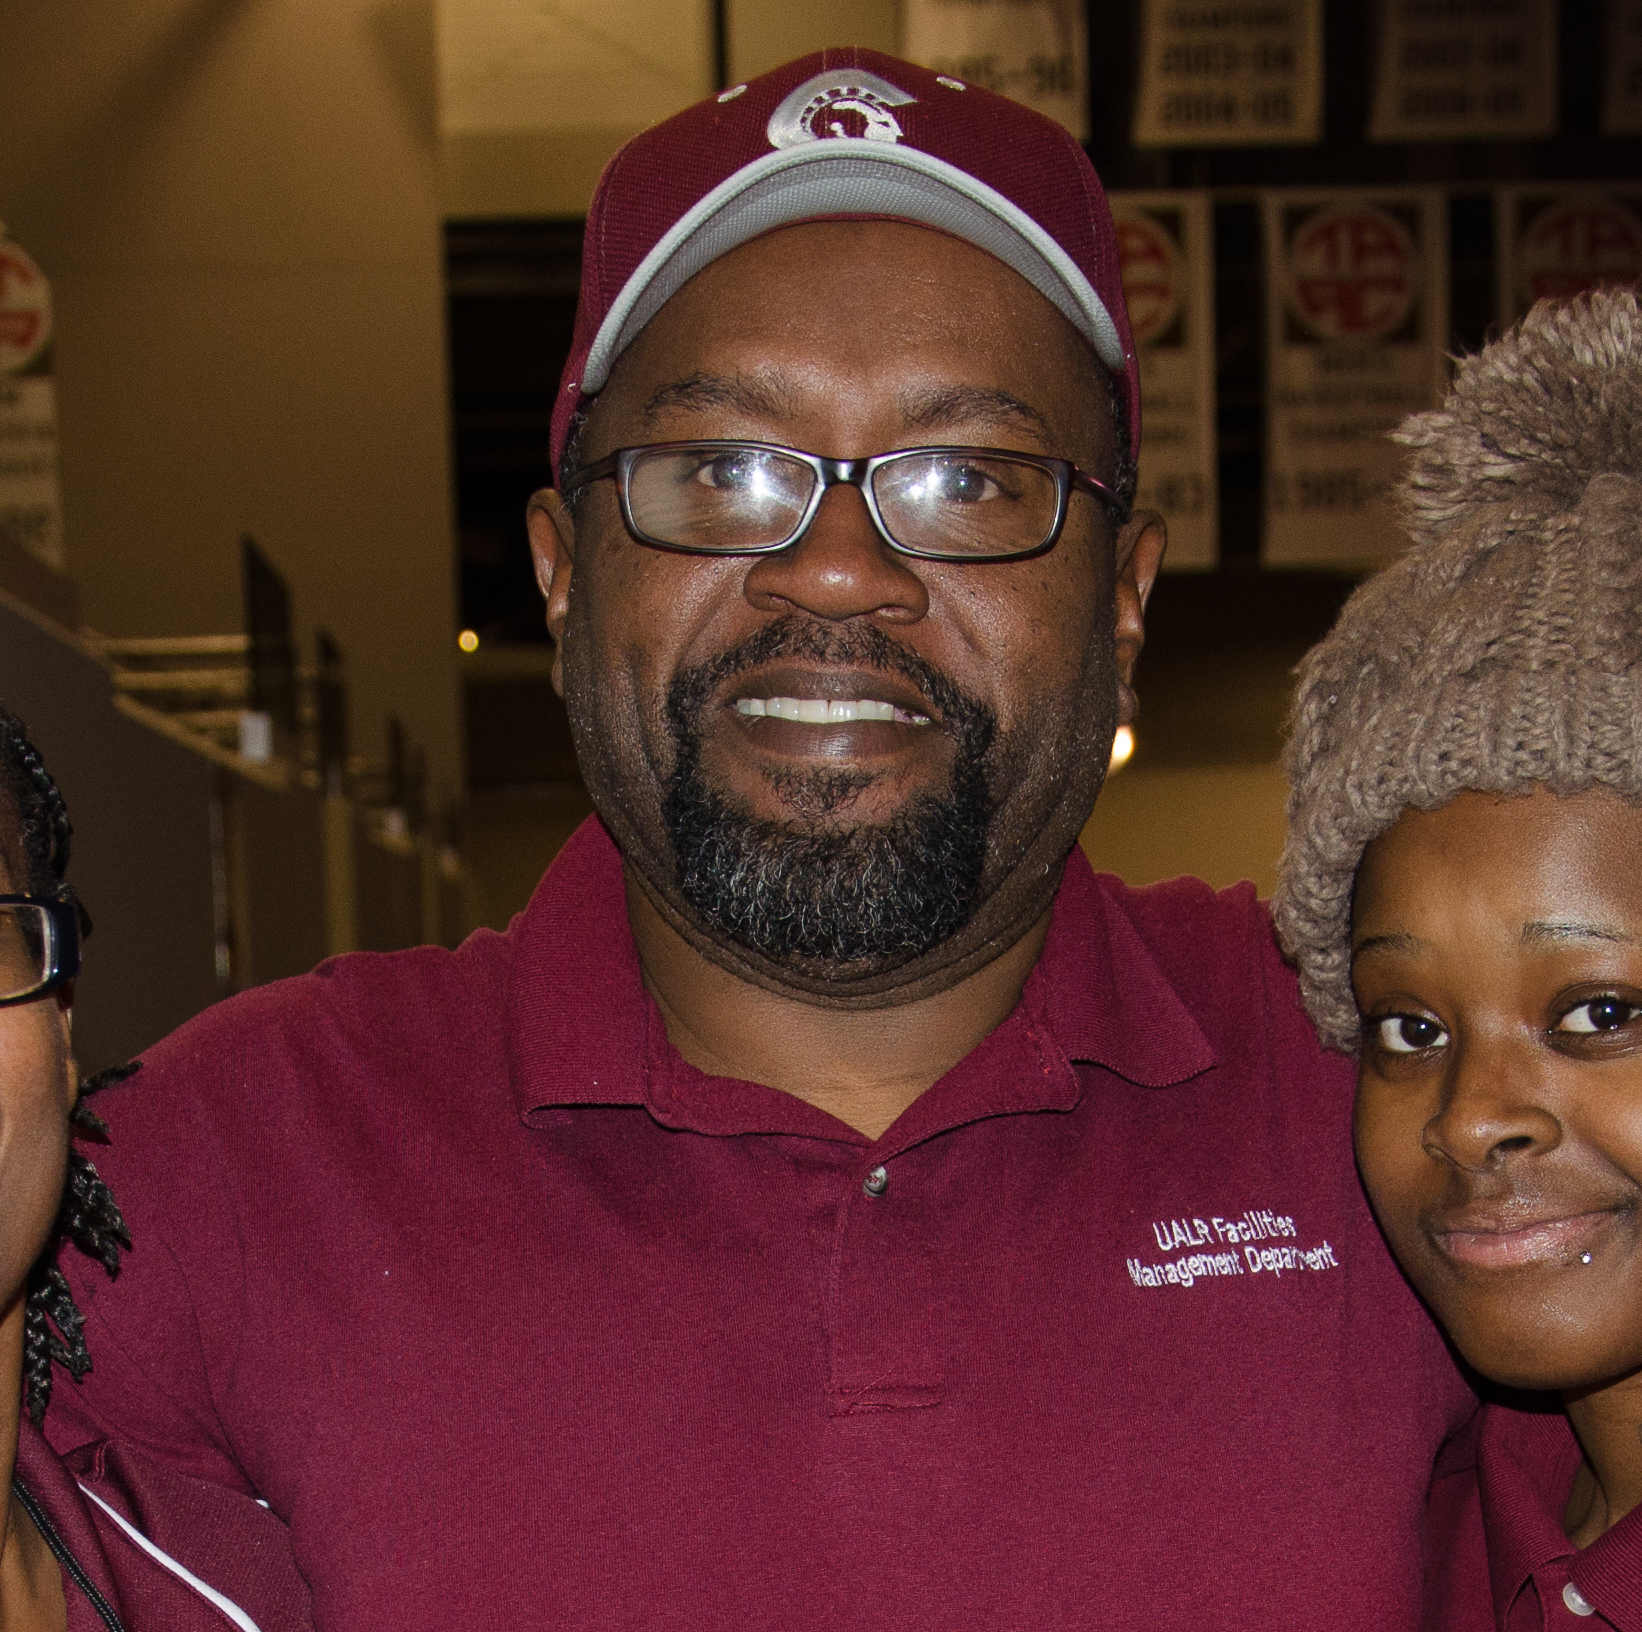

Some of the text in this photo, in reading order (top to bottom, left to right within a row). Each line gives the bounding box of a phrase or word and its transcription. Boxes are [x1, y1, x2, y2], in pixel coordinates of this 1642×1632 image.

[1152, 1208, 1298, 1252] UALR Facilities
[1125, 1239, 1340, 1288] Management Deparent
